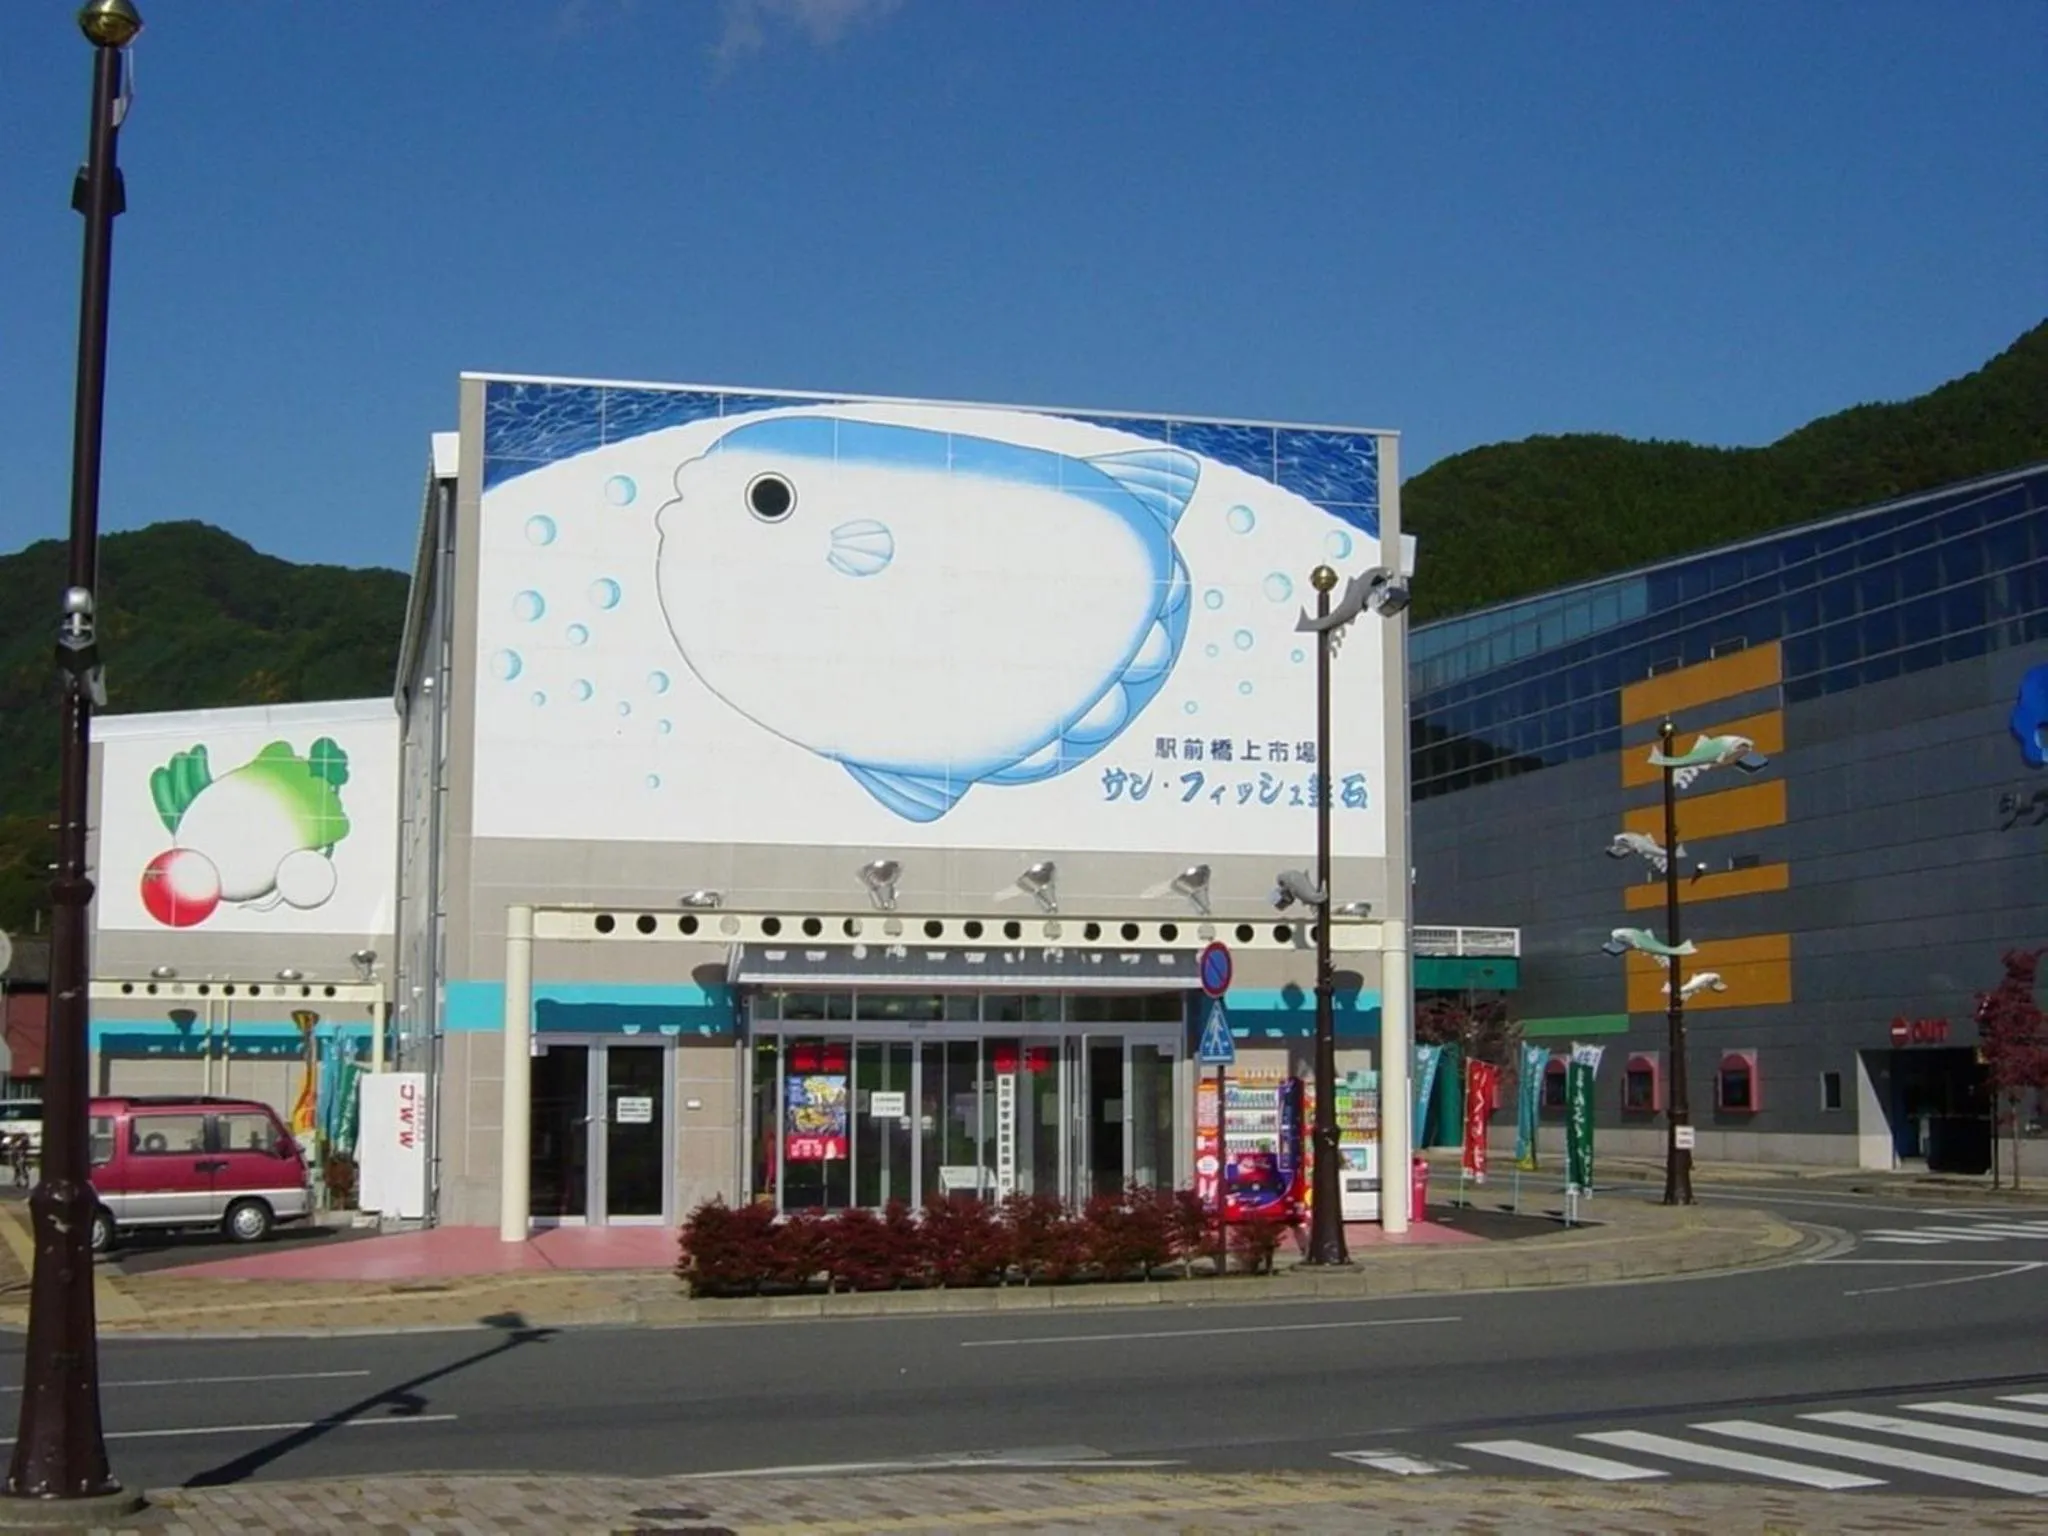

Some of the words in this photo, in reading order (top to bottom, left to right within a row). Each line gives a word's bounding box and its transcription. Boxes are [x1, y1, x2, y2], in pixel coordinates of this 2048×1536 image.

[1154, 737, 1318, 763] 駅前橋上市場
